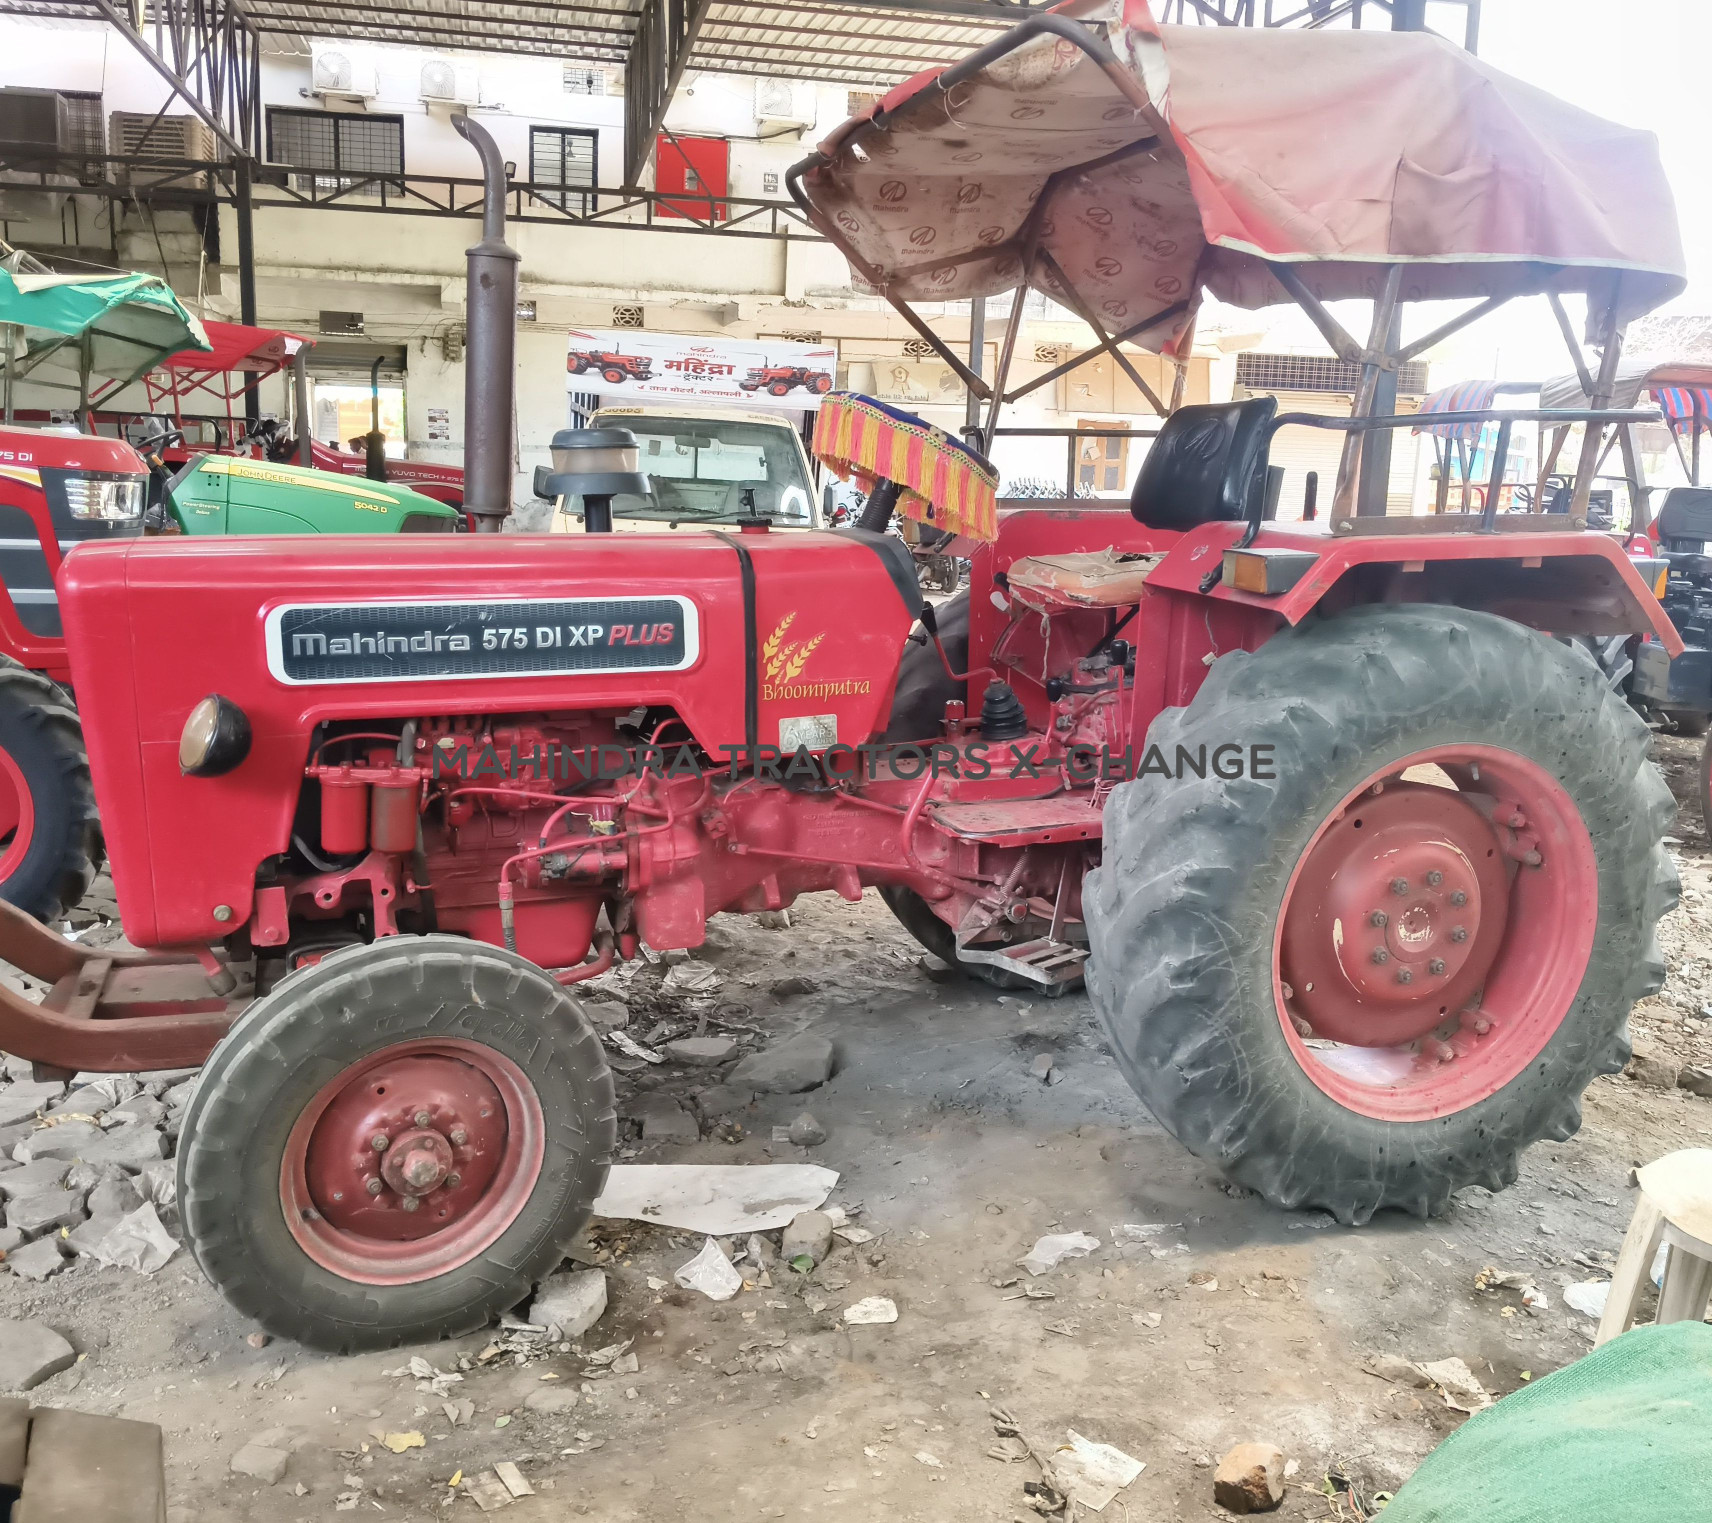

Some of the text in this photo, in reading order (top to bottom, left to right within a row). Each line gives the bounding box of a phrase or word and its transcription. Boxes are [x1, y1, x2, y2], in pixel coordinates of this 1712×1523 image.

[872, 204, 909, 213] Mahindra
[664, 358, 736, 376] महिंद्रा
[18, 452, 33, 461] DI
[418, 472, 440, 480] TECH
[354, 500, 379, 512] 5042
[292, 623, 674, 657] Mahindra 575 DI XP PLUS
[762, 679, 871, 703] Bhoomiputra
[798, 728, 833, 740] YEARS
